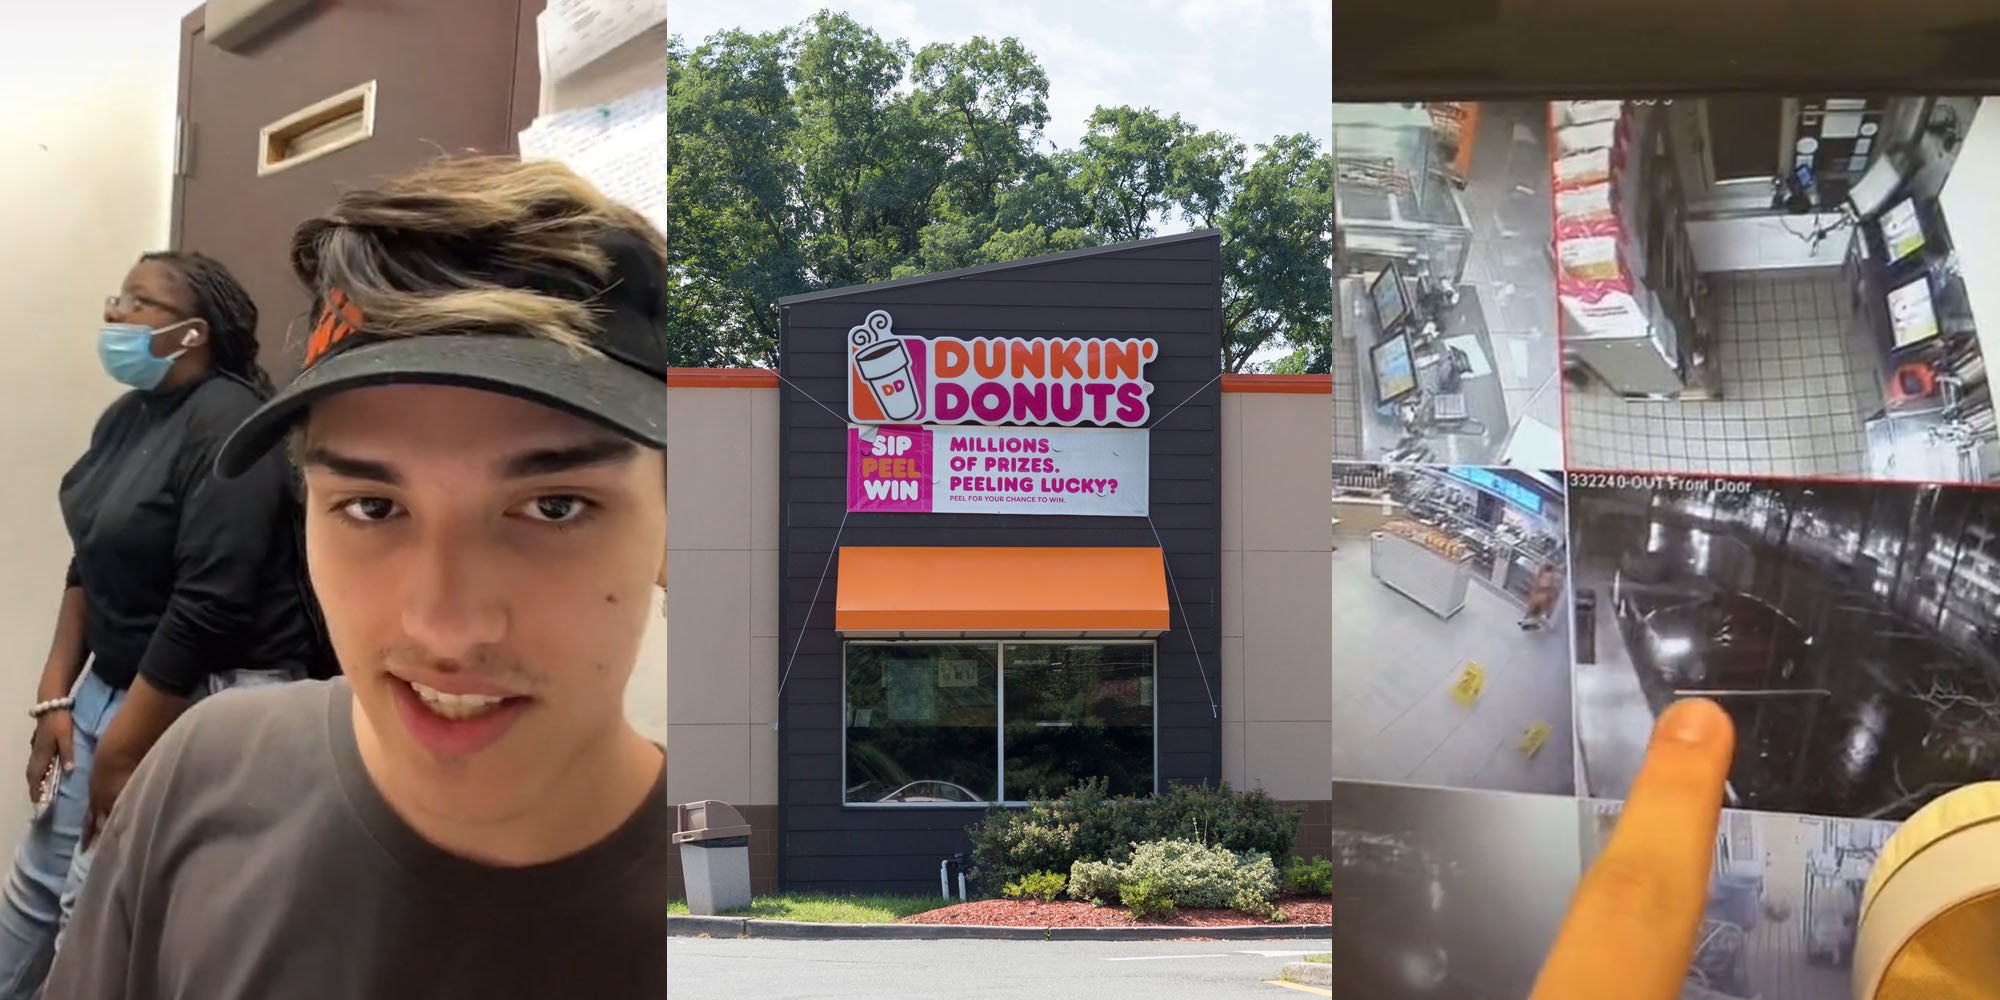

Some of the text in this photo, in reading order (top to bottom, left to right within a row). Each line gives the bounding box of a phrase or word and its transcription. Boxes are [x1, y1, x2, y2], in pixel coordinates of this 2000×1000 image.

[934, 340, 1154, 380] DUNKIN'
[881, 379, 906, 397] DD
[934, 382, 1146, 423] DONUTS
[871, 435, 912, 456] SIP
[949, 436, 1050, 454] MILLIONS
[862, 457, 922, 478] PEEL
[949, 456, 1061, 474] OF PRIZES.
[863, 480, 919, 501] WIN
[949, 476, 1119, 494] PEELING LUCKY?
[1668, 475, 1709, 491] Front
[1714, 478, 1752, 493] Door
[984, 495, 1005, 503] YOUR
[1049, 496, 1067, 504] WIN.
